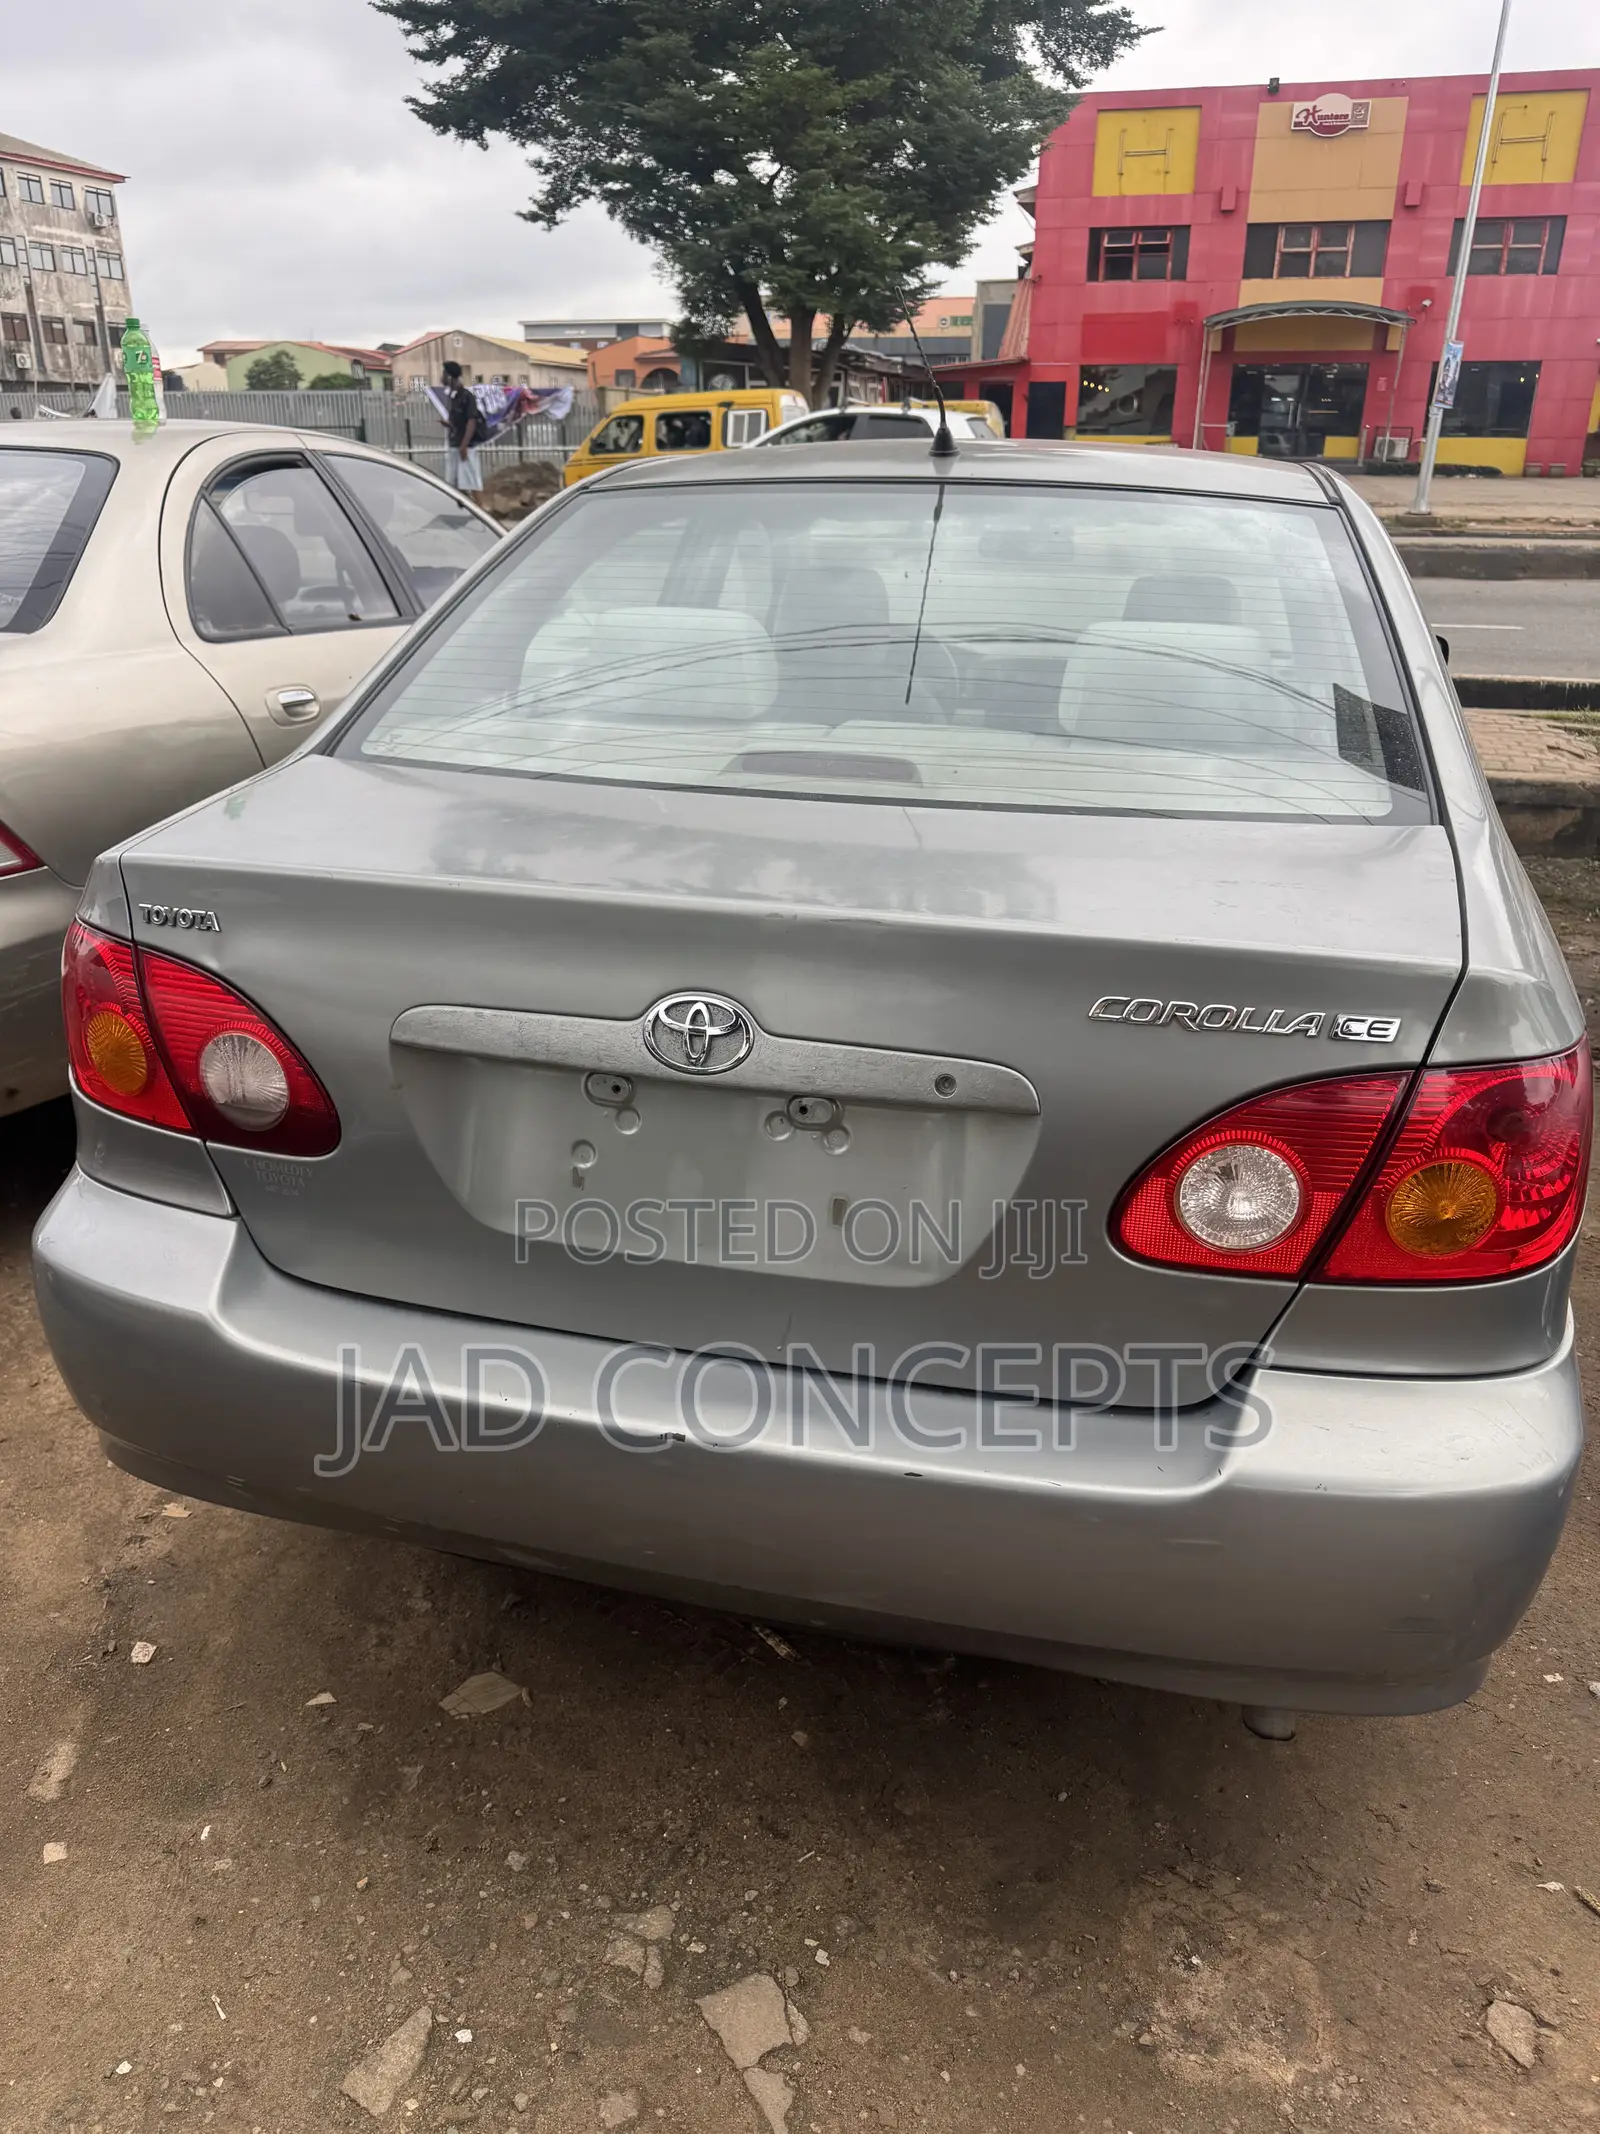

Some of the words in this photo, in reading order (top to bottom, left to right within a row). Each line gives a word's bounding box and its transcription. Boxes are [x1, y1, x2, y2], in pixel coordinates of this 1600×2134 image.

[138, 903, 221, 932] TOYOTA
[1088, 996, 1326, 1038] COROLLA
[1337, 1016, 1396, 1040] CE
